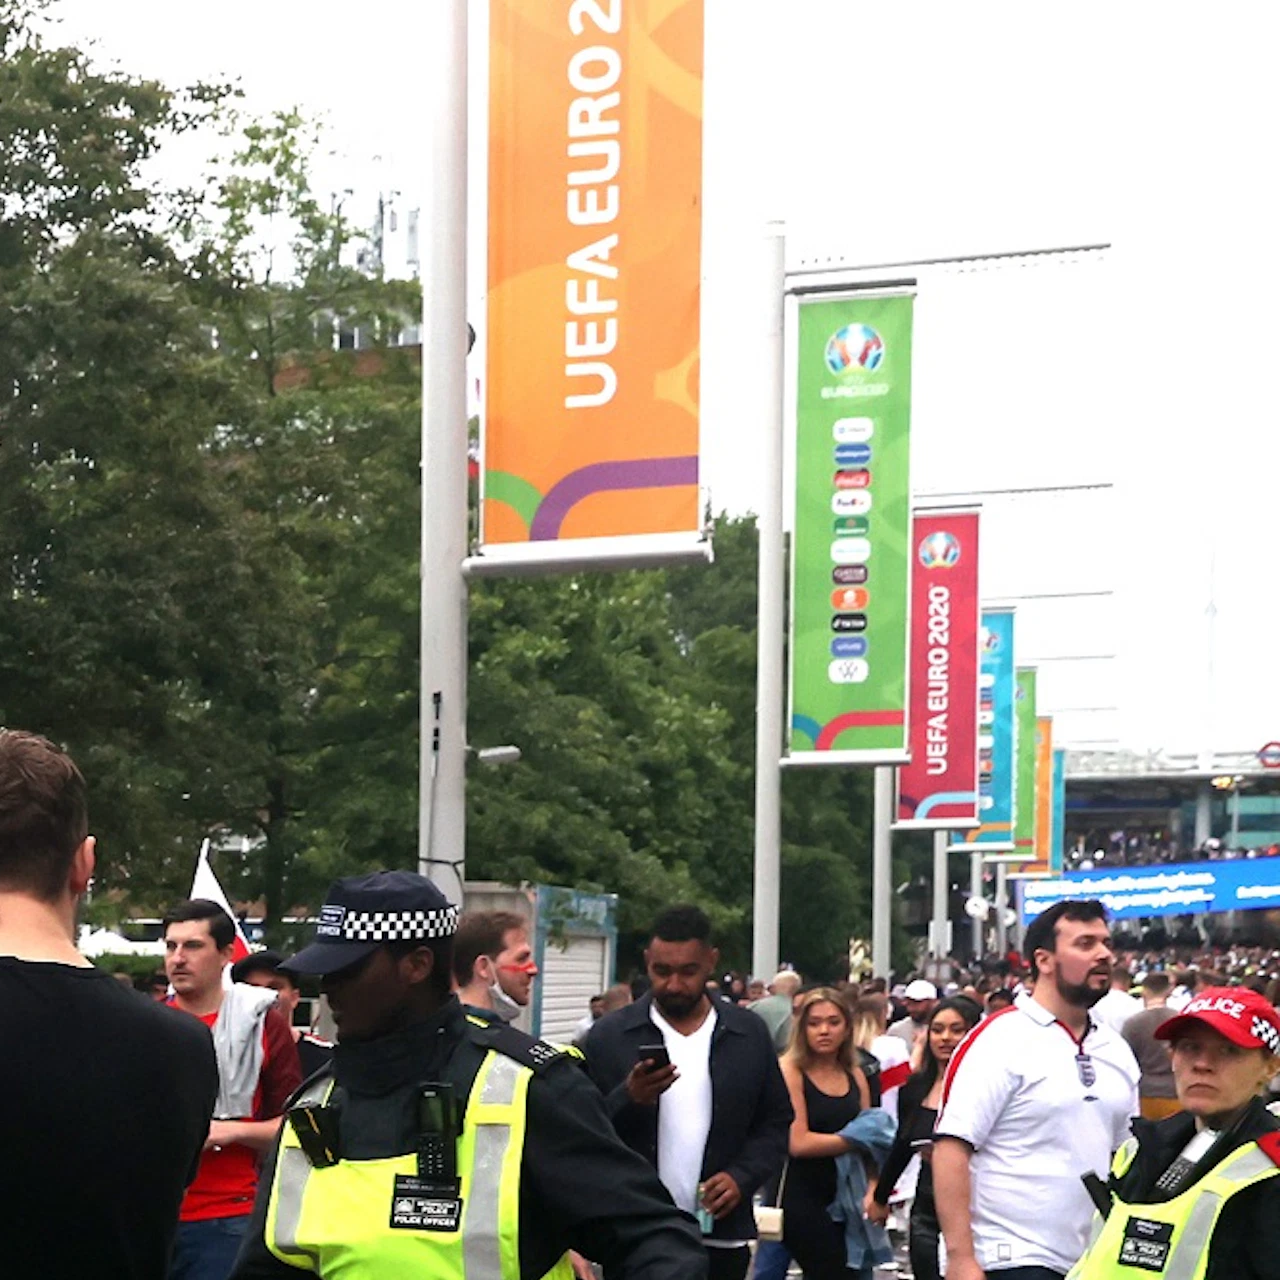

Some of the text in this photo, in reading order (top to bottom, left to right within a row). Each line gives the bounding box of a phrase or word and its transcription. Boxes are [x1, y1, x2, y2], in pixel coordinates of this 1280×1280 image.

[566, 46, 623, 225] EURO
[565, 232, 620, 409] UEFA
[926, 585, 950, 775] UEFA EURO 2020
[1183, 997, 1246, 1019] POLICE
